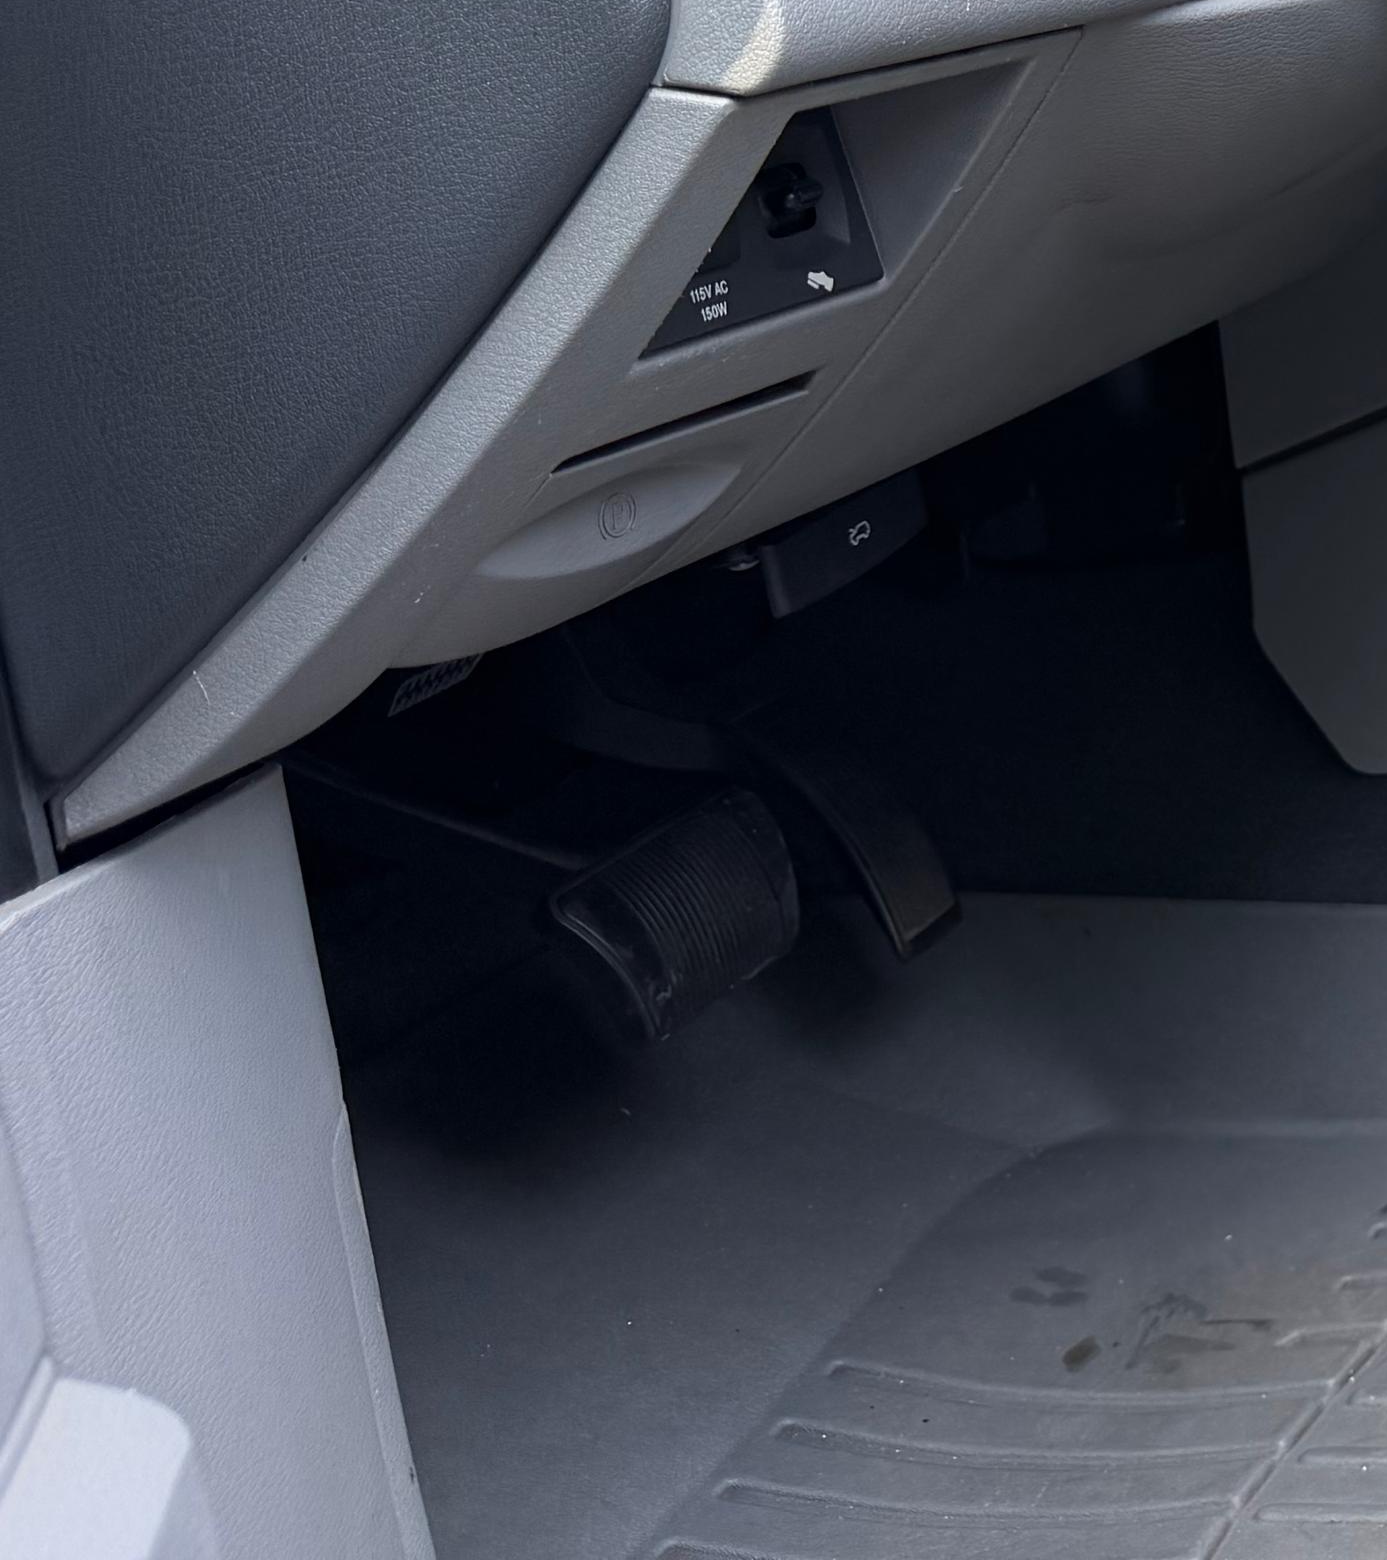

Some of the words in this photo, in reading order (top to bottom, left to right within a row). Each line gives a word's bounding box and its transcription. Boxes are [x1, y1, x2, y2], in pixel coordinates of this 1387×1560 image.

[690, 284, 712, 304] 115V
[715, 279, 729, 297] AC
[701, 300, 728, 323] 150W
